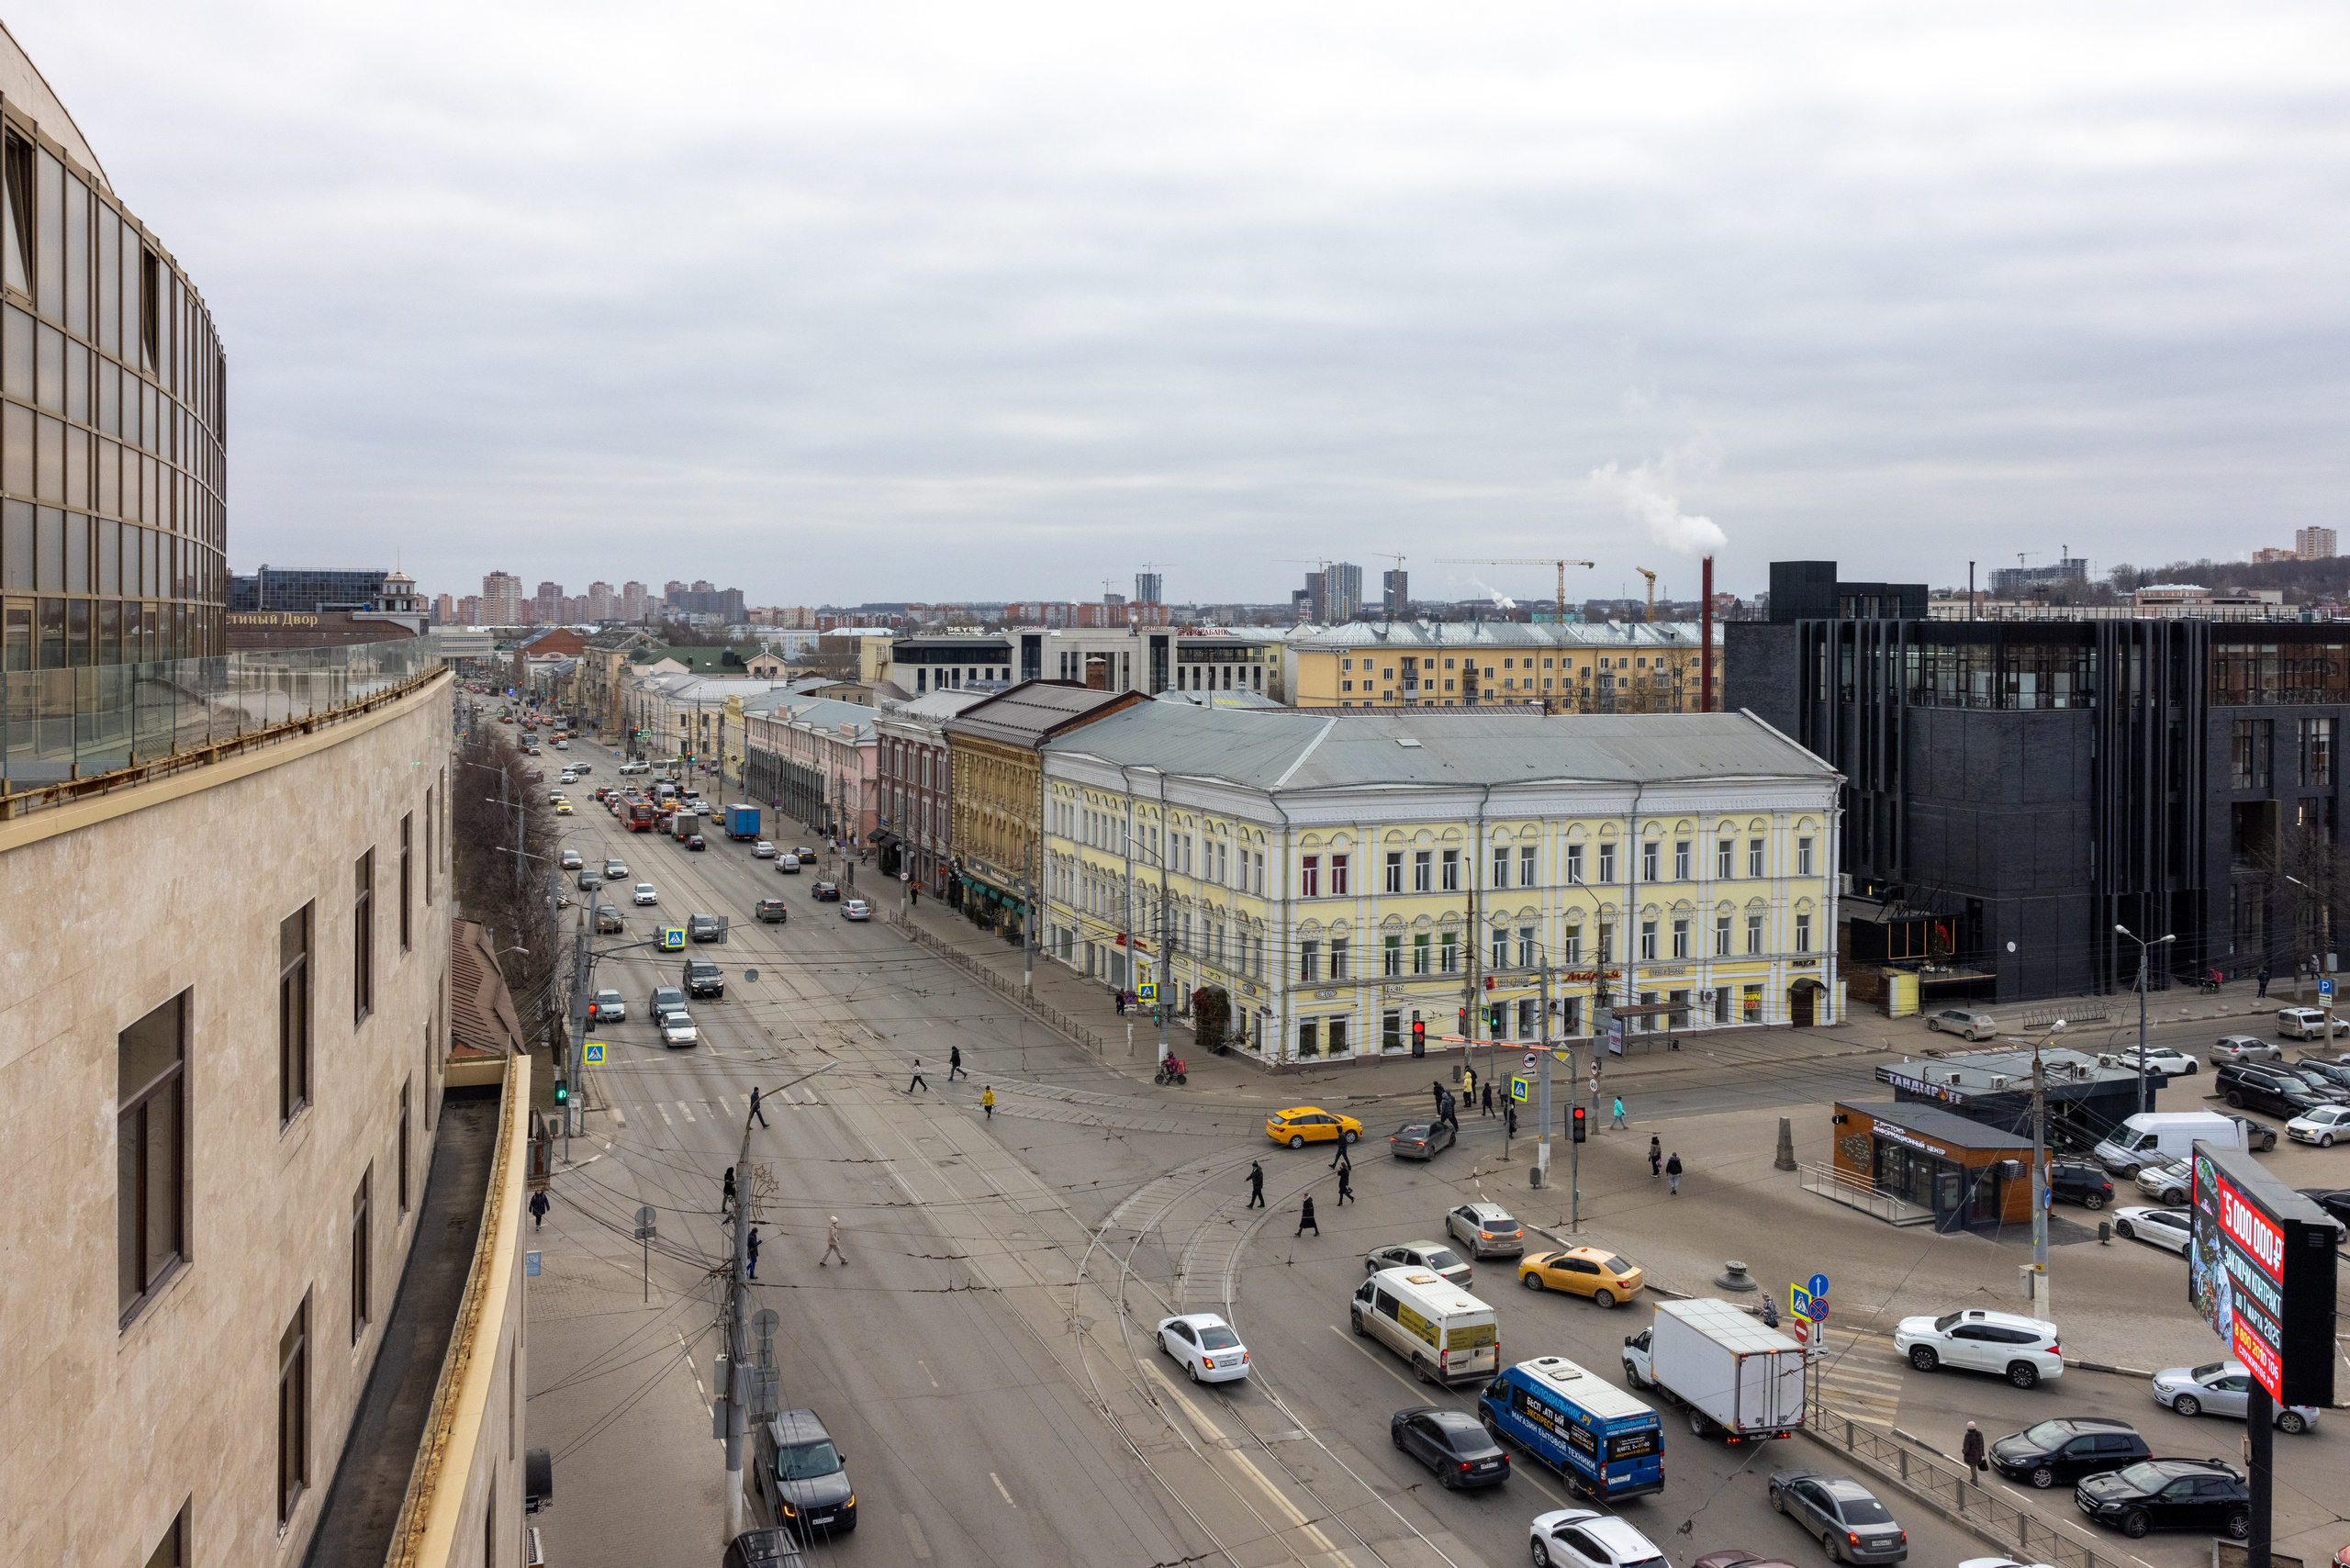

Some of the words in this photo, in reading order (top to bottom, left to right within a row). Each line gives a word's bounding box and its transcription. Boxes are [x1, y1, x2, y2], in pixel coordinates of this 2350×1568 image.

[282, 612, 318, 627] Двор
[1874, 1126, 1925, 1148] ИНФОРМАЦИОННЫЙ
[1927, 1145, 1946, 1156] ЦЕНТР
[2224, 1245, 2251, 1289] ЗАКЛЮЧИ
[2252, 1271, 2281, 1318] КОНТРАКТ
[2247, 1304, 2263, 1332] МАРТА
[2264, 1316, 2279, 1349] 2025
[2234, 1323, 2239, 1336] 8
[2240, 1328, 2251, 1350] 800
[2252, 1341, 2266, 1366] 2010
[2267, 1359, 2278, 1380] 106
[1511, 1411, 1537, 1431] МАГАЗИН
[1539, 1428, 1566, 1451] БЫТОВОЙ
[1568, 1446, 1595, 1471] ТЕХНИКИ
[1526, 1406, 1554, 1431] ЭКСПРЕСС
